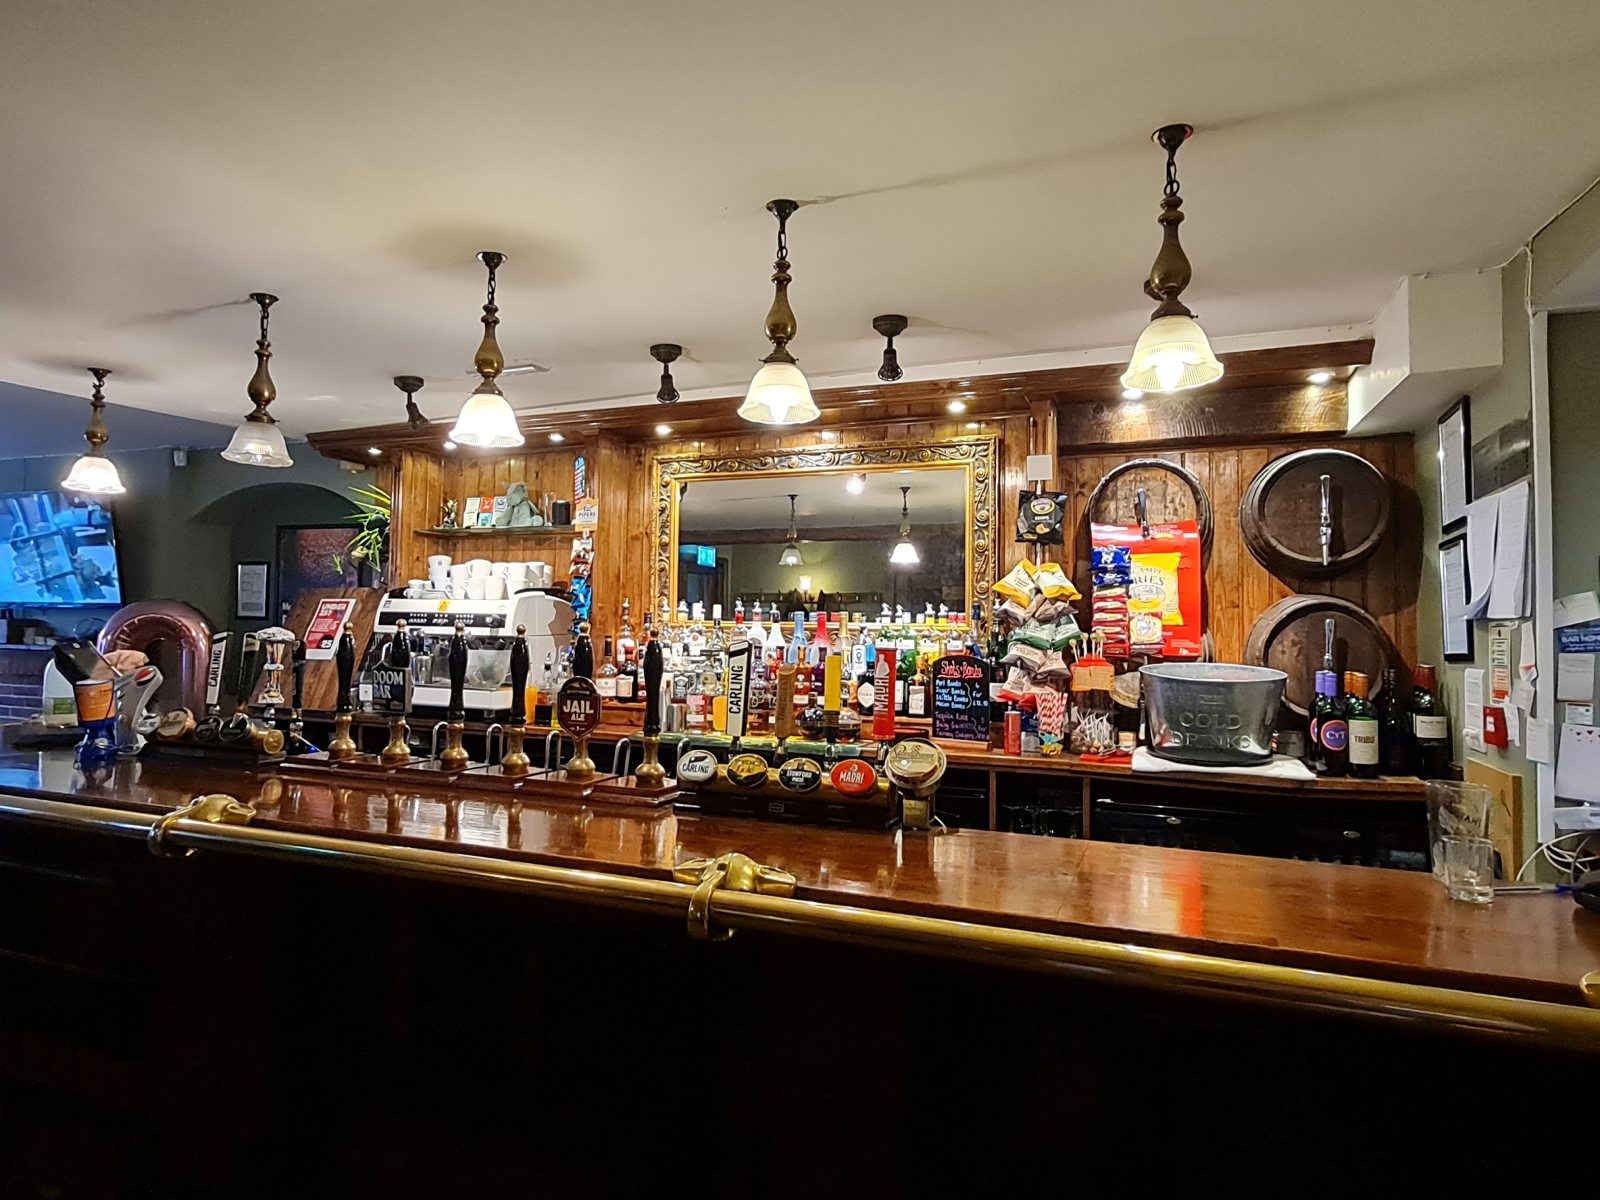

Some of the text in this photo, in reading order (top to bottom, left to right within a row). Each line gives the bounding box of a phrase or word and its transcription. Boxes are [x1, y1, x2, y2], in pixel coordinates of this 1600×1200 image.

[208, 649, 223, 688] CARLING
[373, 670, 404, 686] DOOM
[373, 683, 392, 699] BAR
[728, 665, 745, 715] CARLING
[562, 699, 595, 714] JAIL
[570, 713, 586, 721] ALE
[1179, 711, 1242, 730] COLD
[681, 761, 710, 774] CARLING
